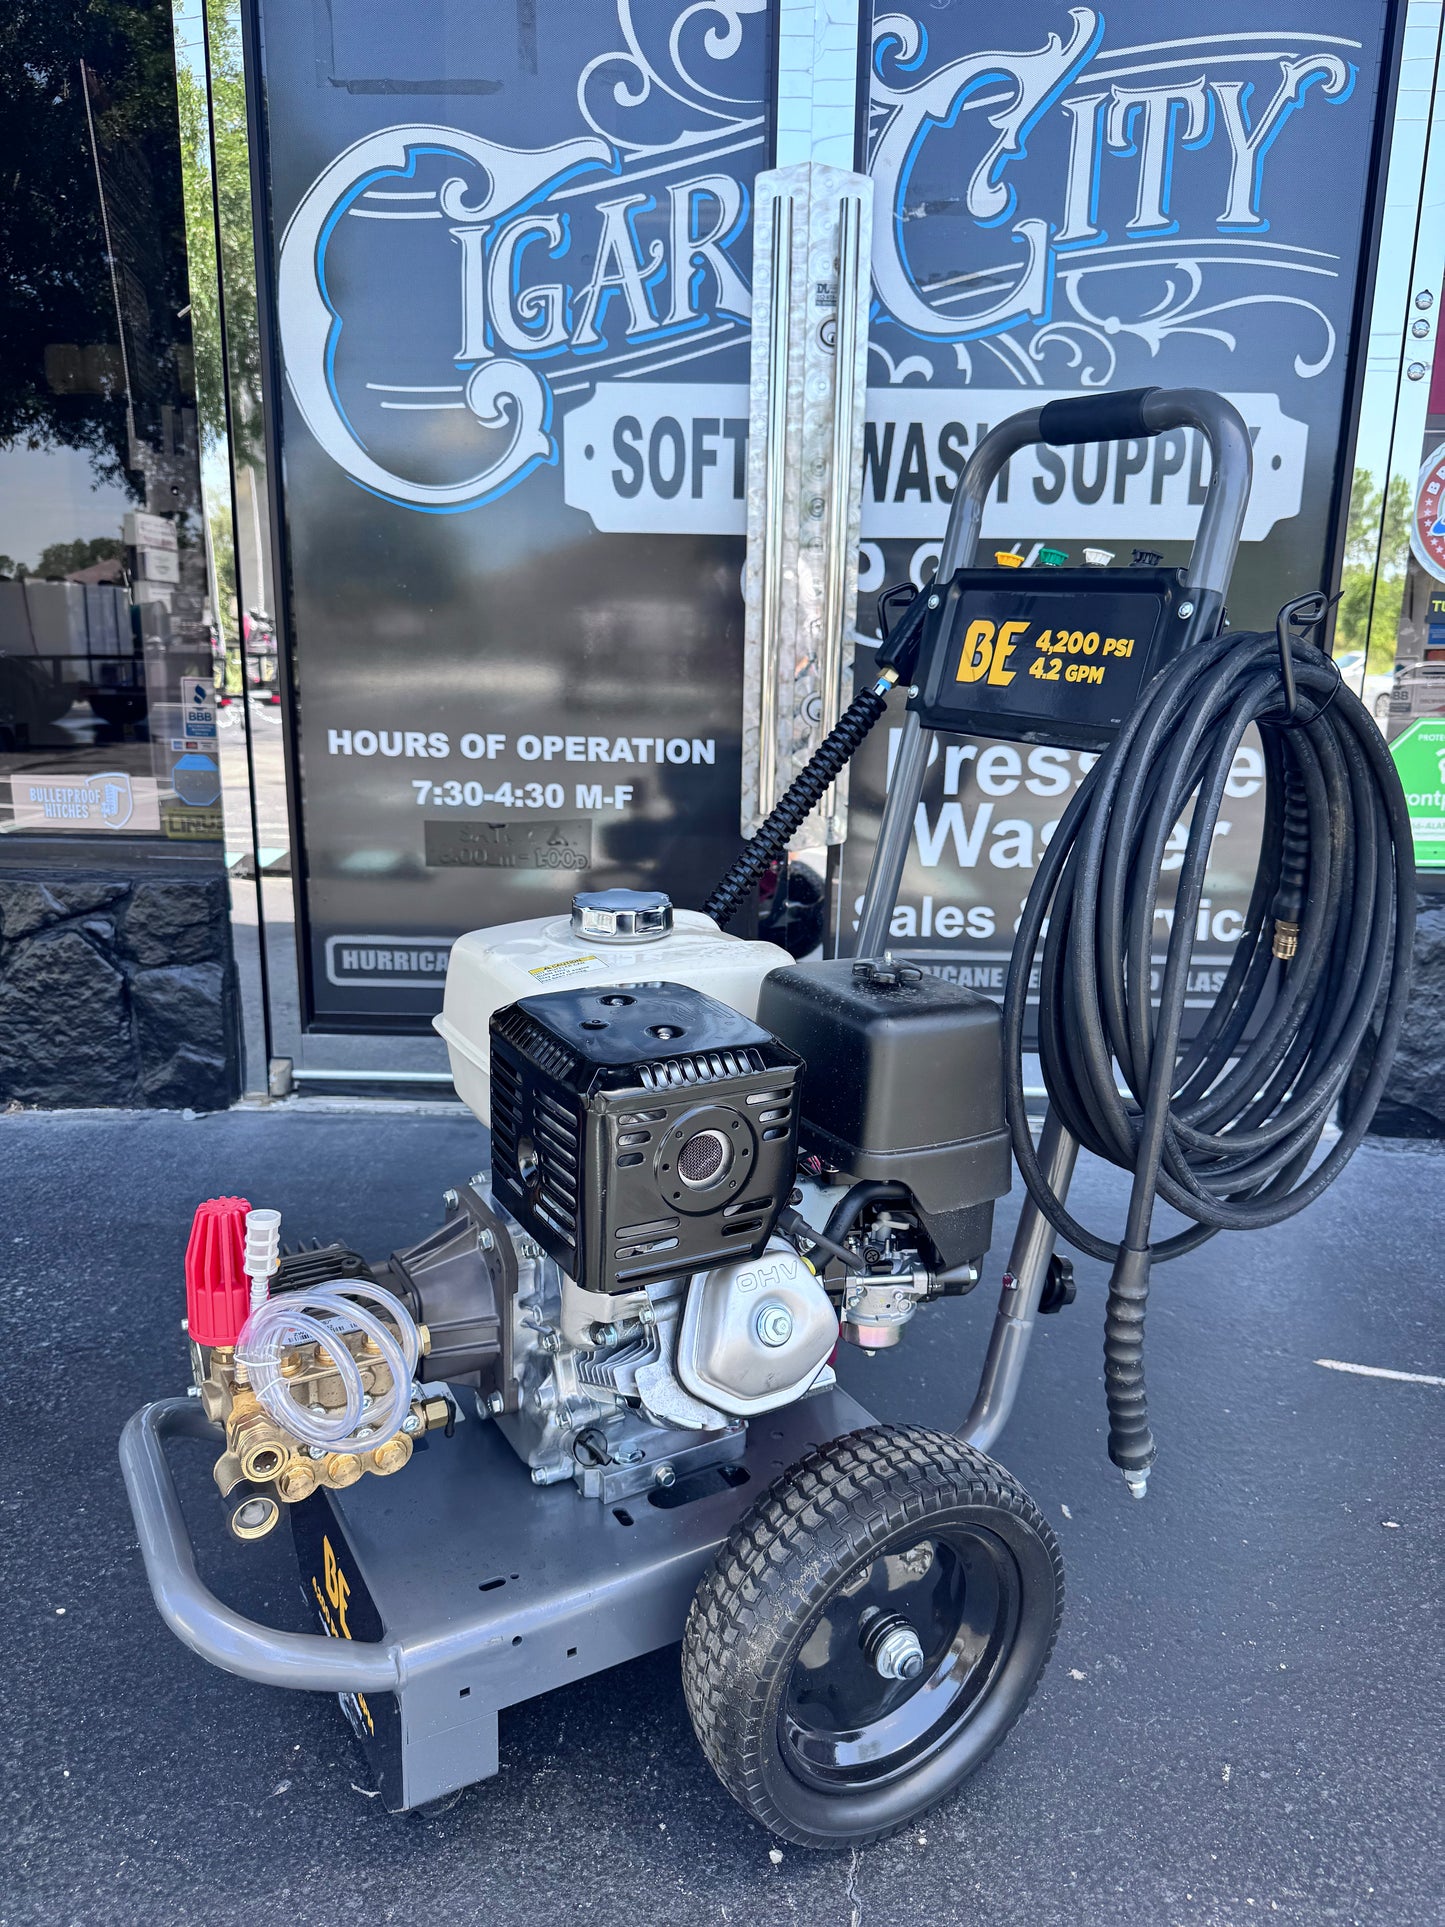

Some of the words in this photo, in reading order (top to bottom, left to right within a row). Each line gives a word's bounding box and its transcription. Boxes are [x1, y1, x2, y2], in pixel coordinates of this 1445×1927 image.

[279, 124, 752, 513] CIGAR
[868, 6, 1358, 343] CITY
[612, 415, 750, 500] SOFT
[1032, 425, 1261, 505] SUPPL
[956, 620, 1031, 686] BE
[1035, 630, 1100, 655] 4,200
[1102, 638, 1135, 657] PSI
[1029, 658, 1063, 681] 4.2
[1065, 664, 1105, 684] GPM
[188, 711, 212, 722] BBB
[328, 729, 450, 758] HOURS
[460, 733, 506, 759] OF
[517, 734, 716, 765] OPERATION
[29, 787, 101, 804] BULLETPROOF
[412, 780, 565, 809] 7:30-4:30
[575, 784, 634, 809] M-F
[44, 803, 89, 819] HITCHES
[342, 949, 449, 972] HURRICA
[736, 1260, 798, 1293] OHV
